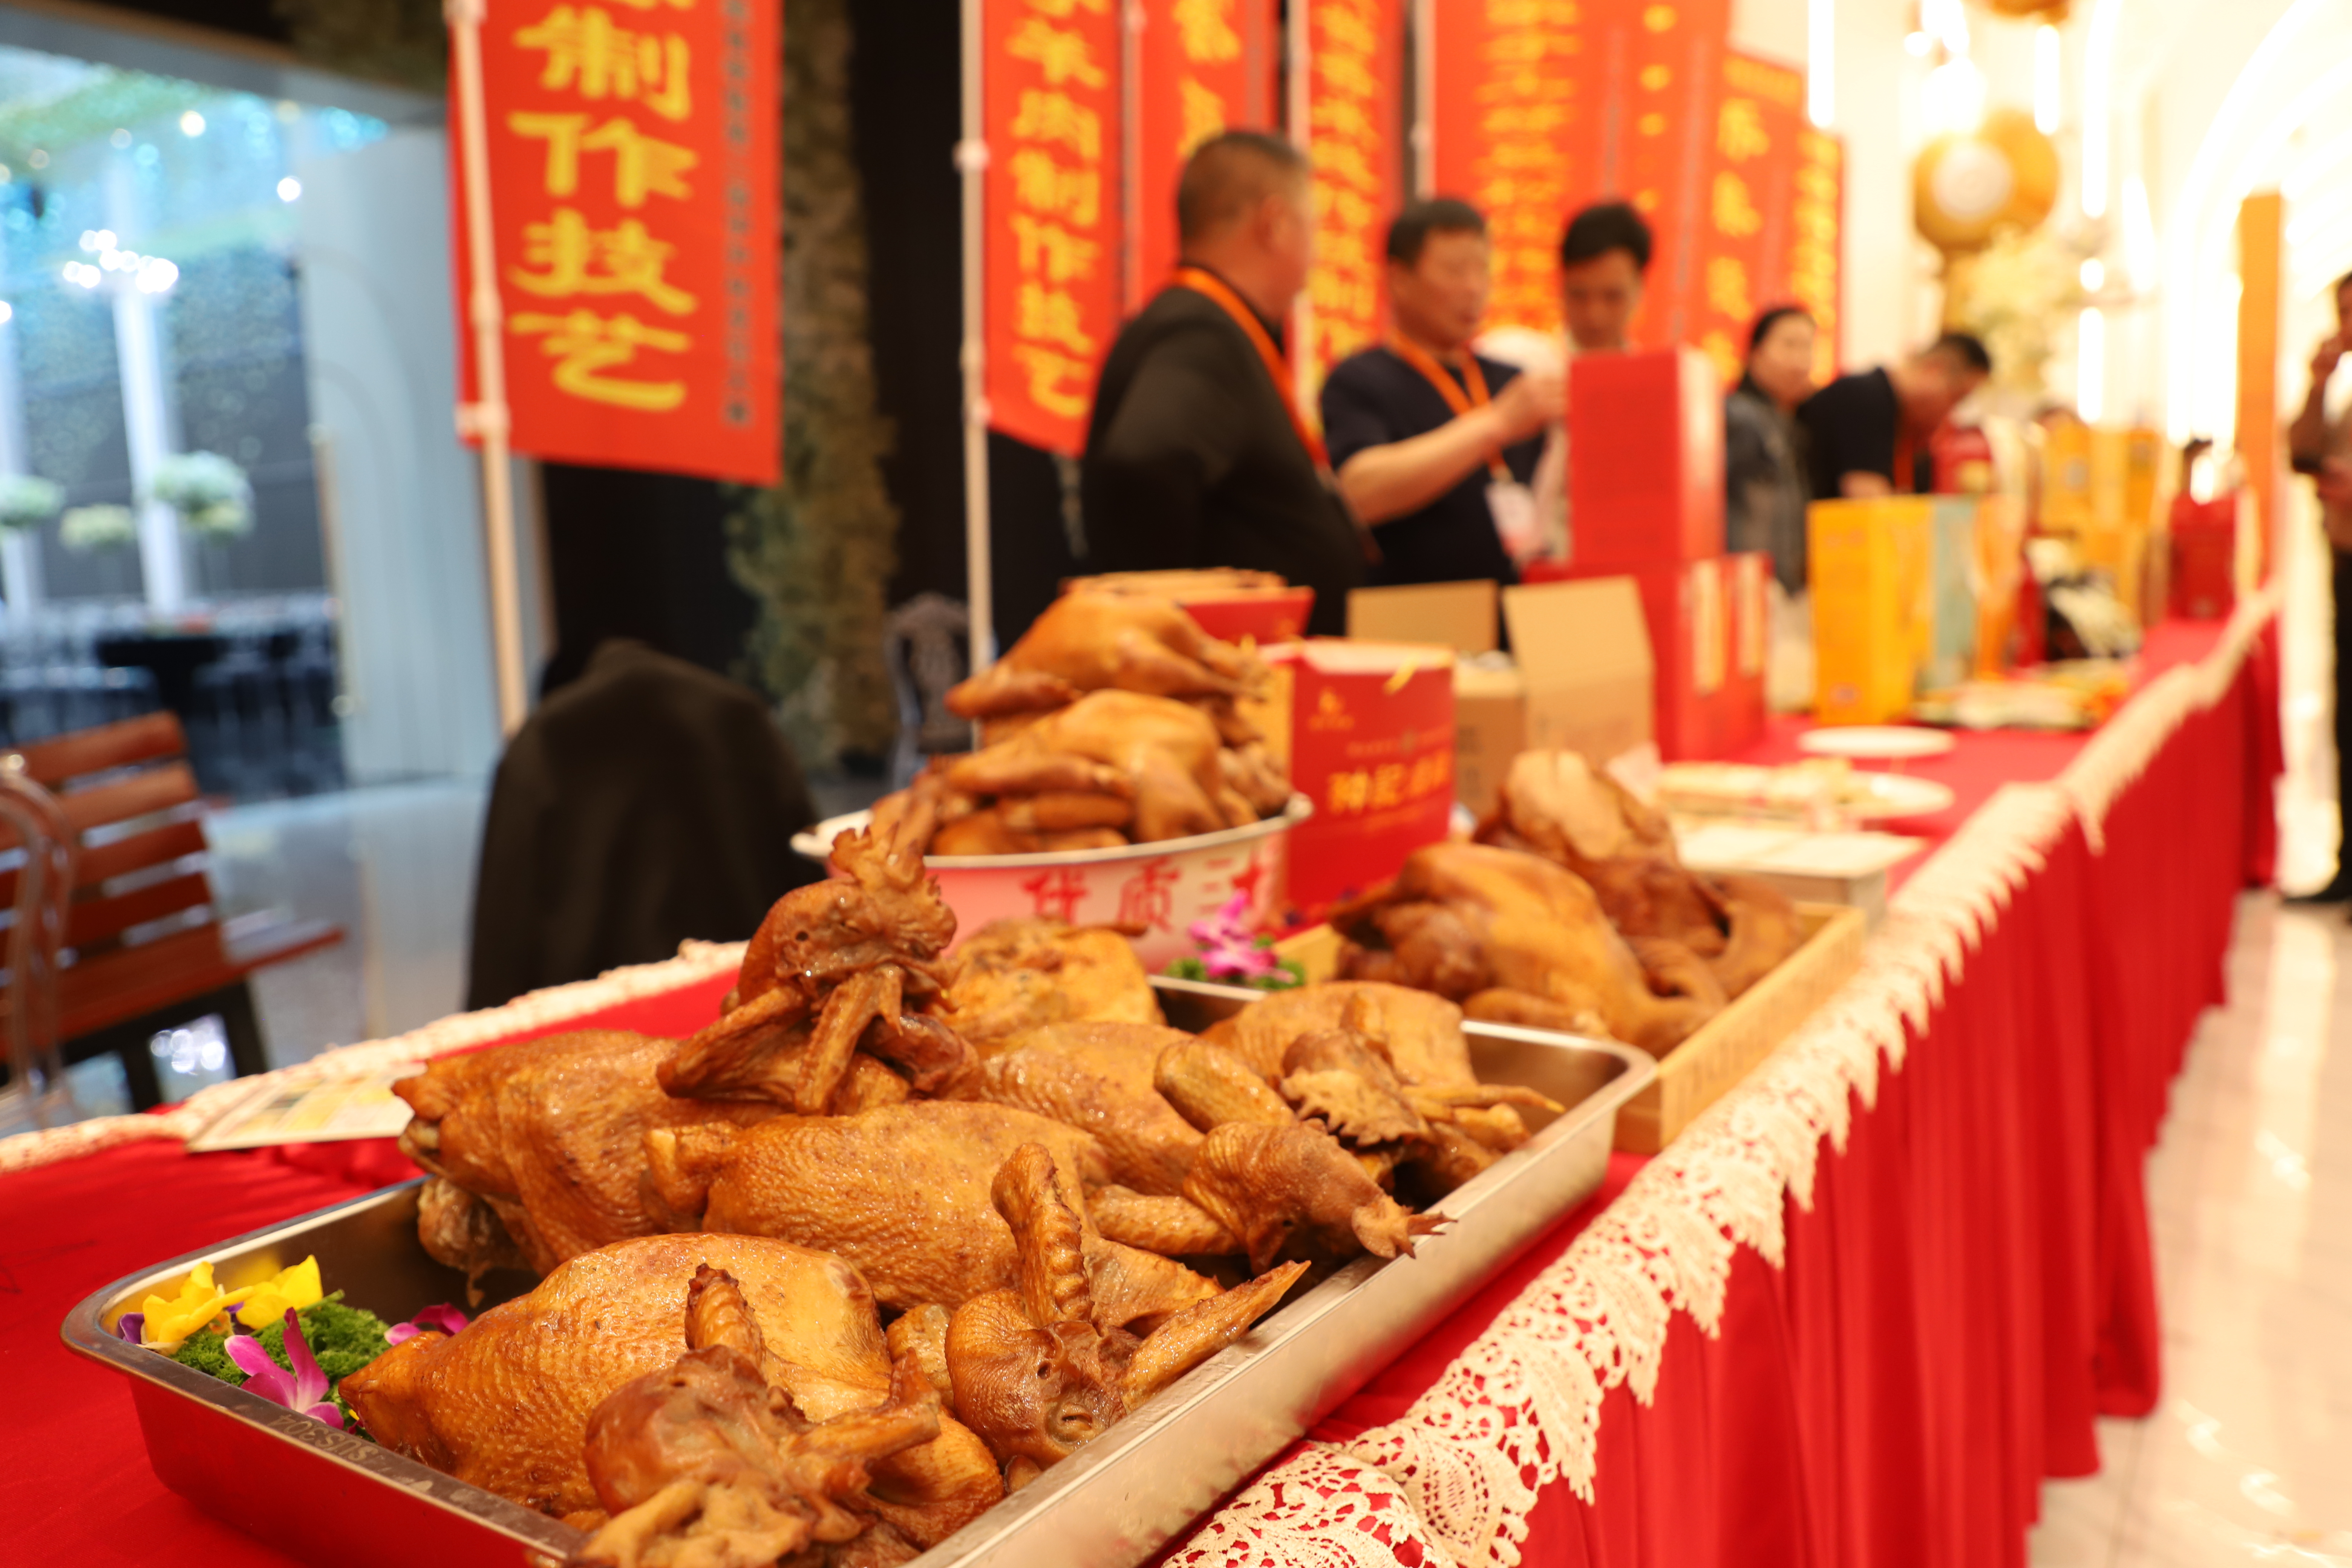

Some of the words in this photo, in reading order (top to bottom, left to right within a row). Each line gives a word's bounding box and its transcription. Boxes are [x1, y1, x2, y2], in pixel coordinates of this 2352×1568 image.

[506, 0, 700, 412] 制作技艺
[265, 1413, 379, 1461] SUS304
